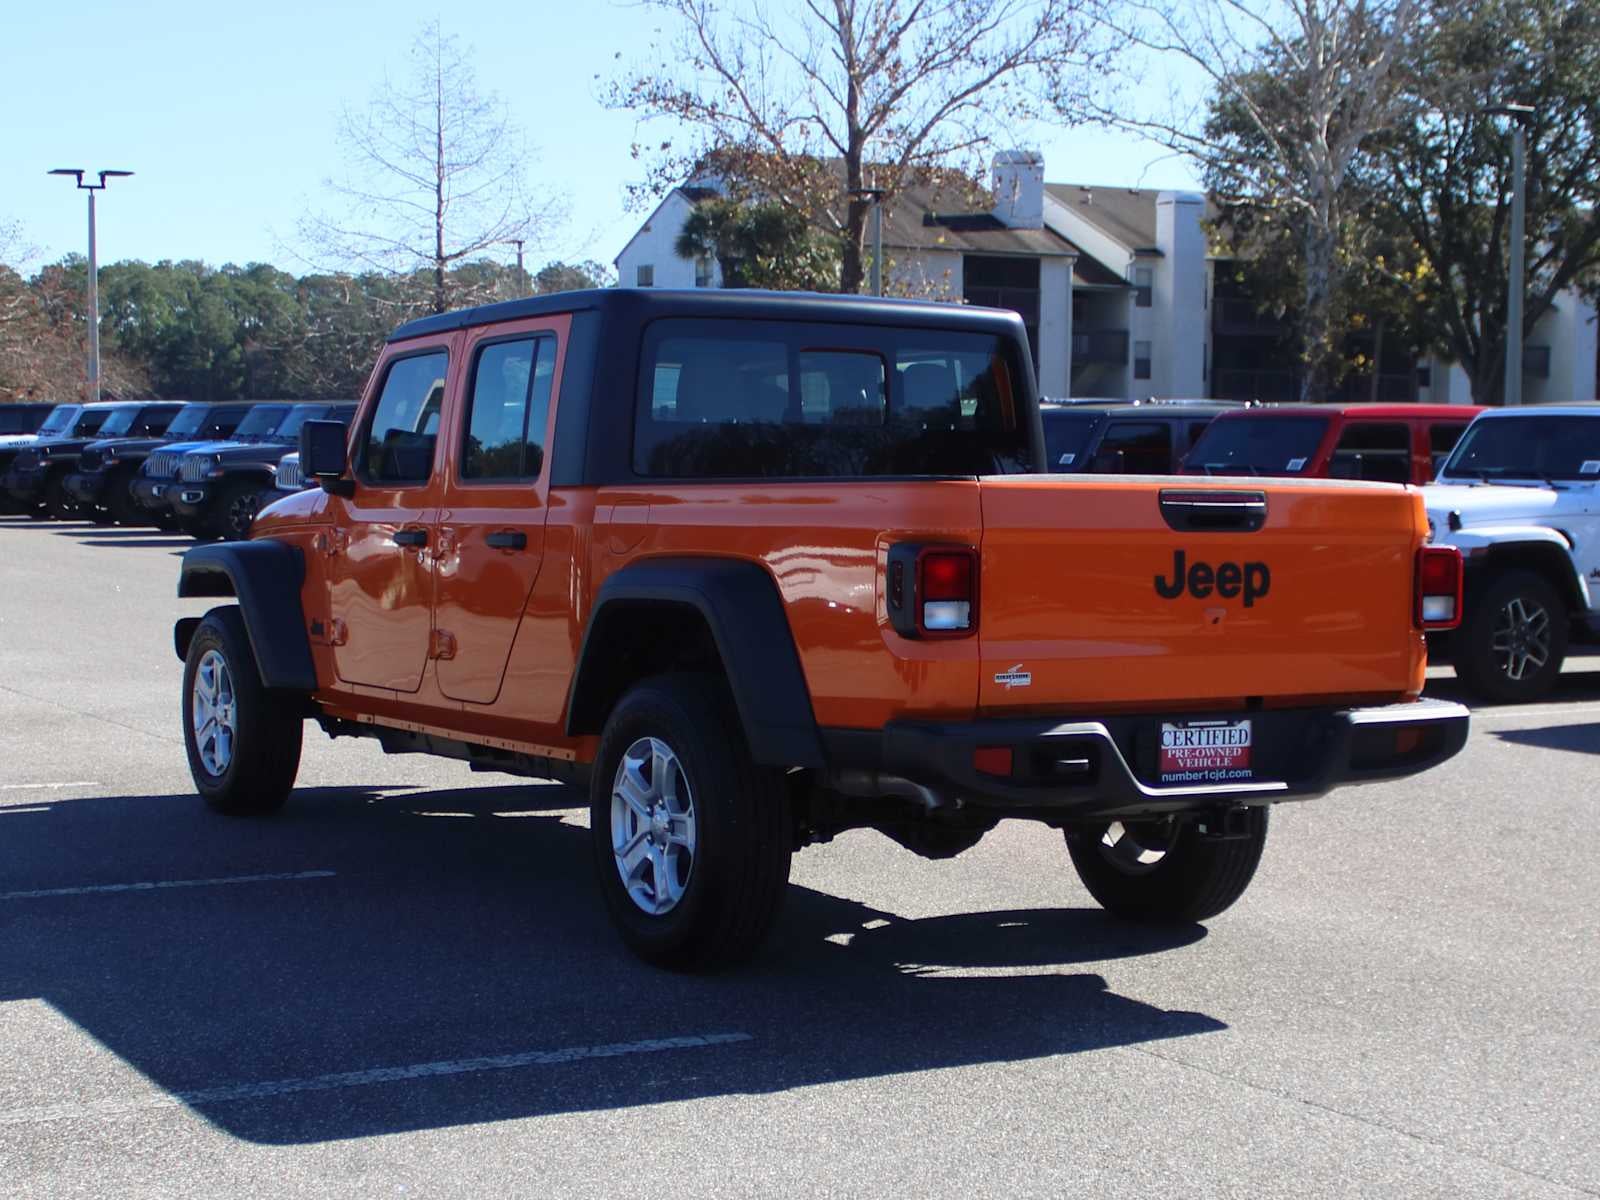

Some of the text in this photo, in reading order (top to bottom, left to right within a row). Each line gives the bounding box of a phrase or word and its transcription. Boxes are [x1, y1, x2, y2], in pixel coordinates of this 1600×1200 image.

[1154, 550, 1271, 608] Jeep
[1162, 729, 1248, 746] CERTIFIED
[1167, 747, 1242, 758] PRE-OWNED
[1177, 758, 1233, 768] VEHICLE
[1161, 769, 1252, 782] number1cjd.com
